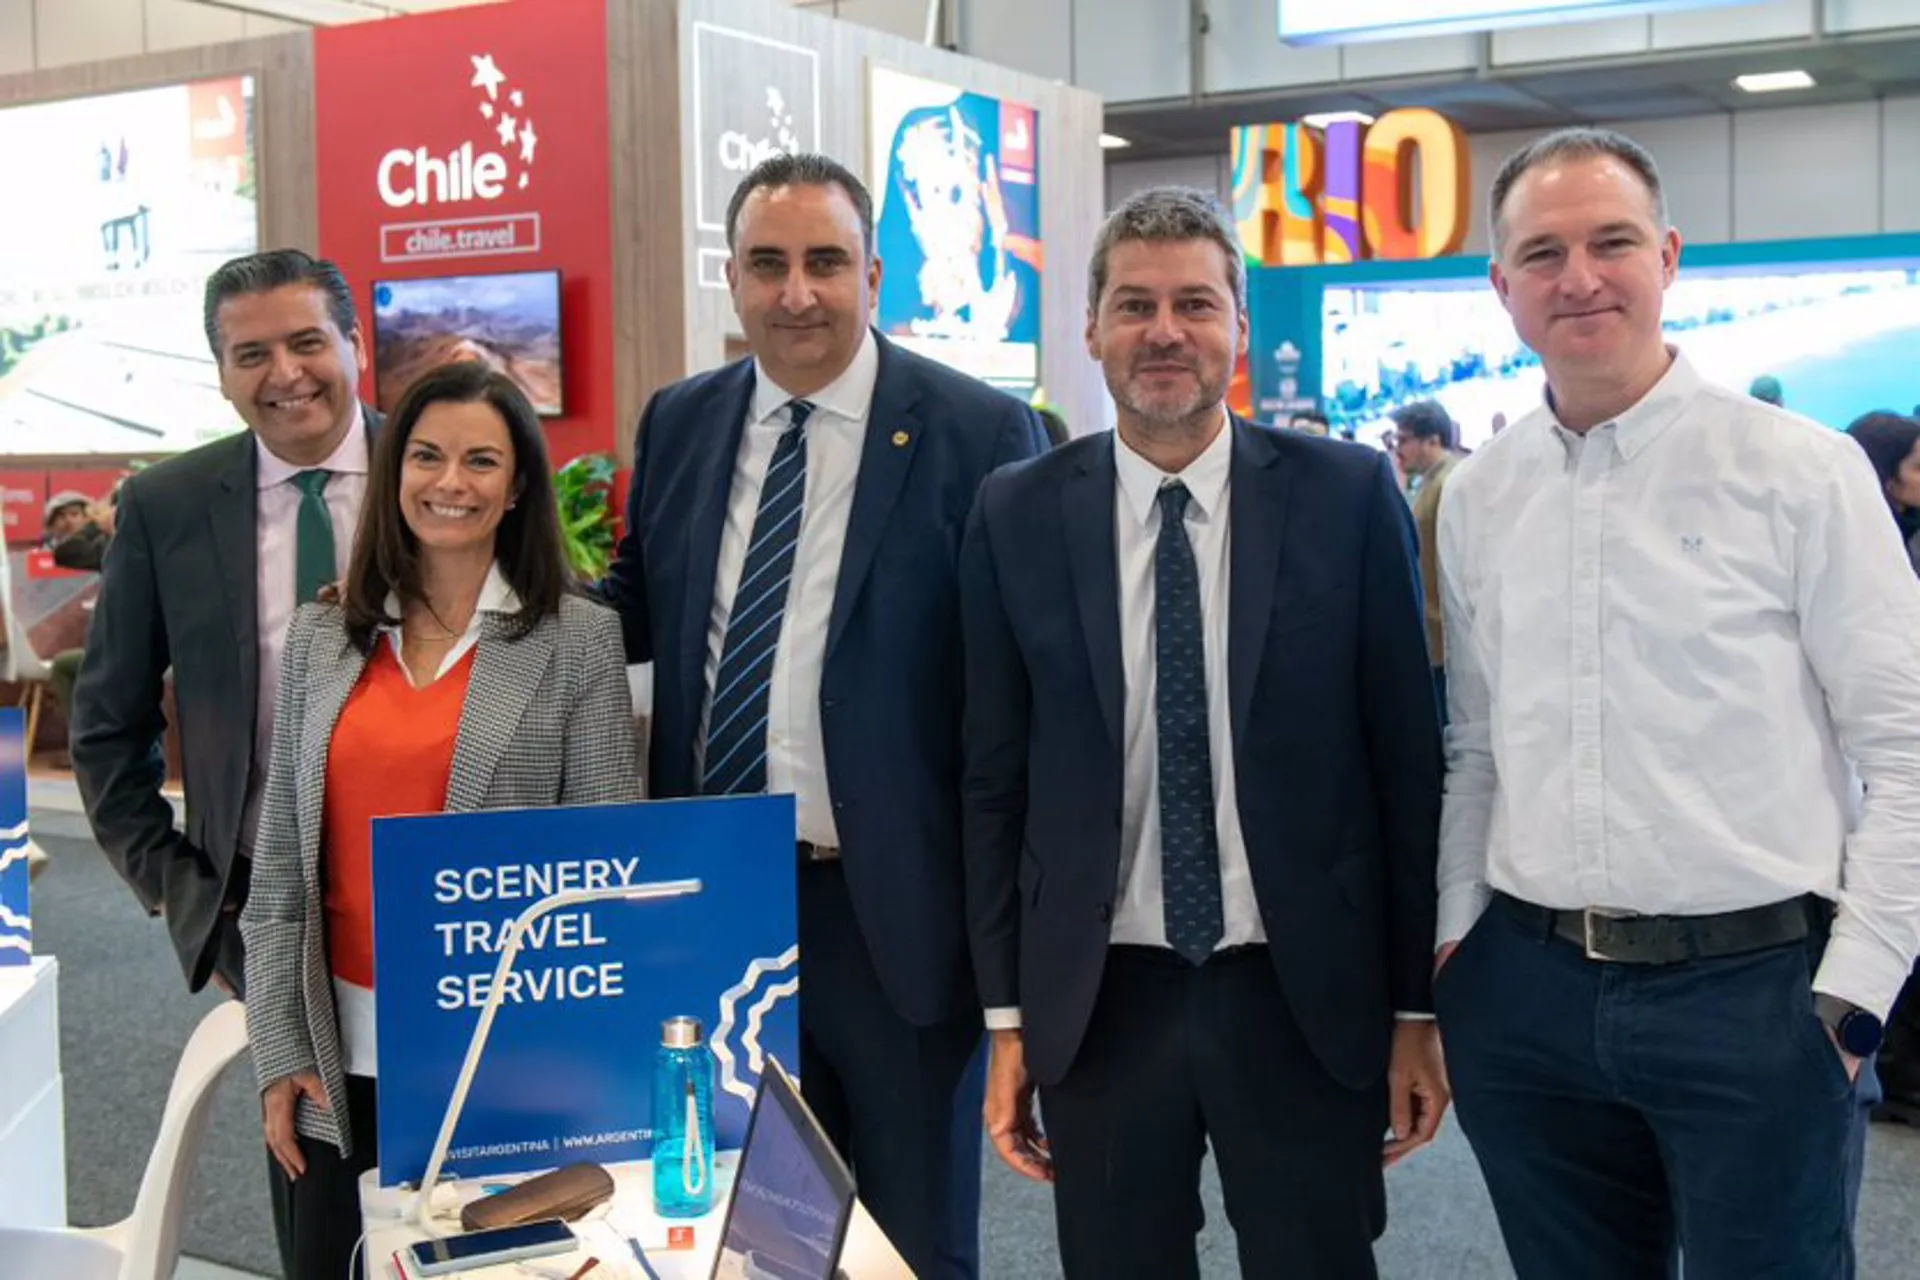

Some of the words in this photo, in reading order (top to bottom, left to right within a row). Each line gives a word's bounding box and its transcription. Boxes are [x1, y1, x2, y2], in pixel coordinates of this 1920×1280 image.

[377, 141, 507, 207] Chile
[1231, 107, 1470, 266] RIO
[405, 222, 515, 252] chile.travel
[434, 857, 640, 903] SCENERY
[434, 912, 607, 956] TRAVEL
[436, 962, 624, 1010] SERVICE
